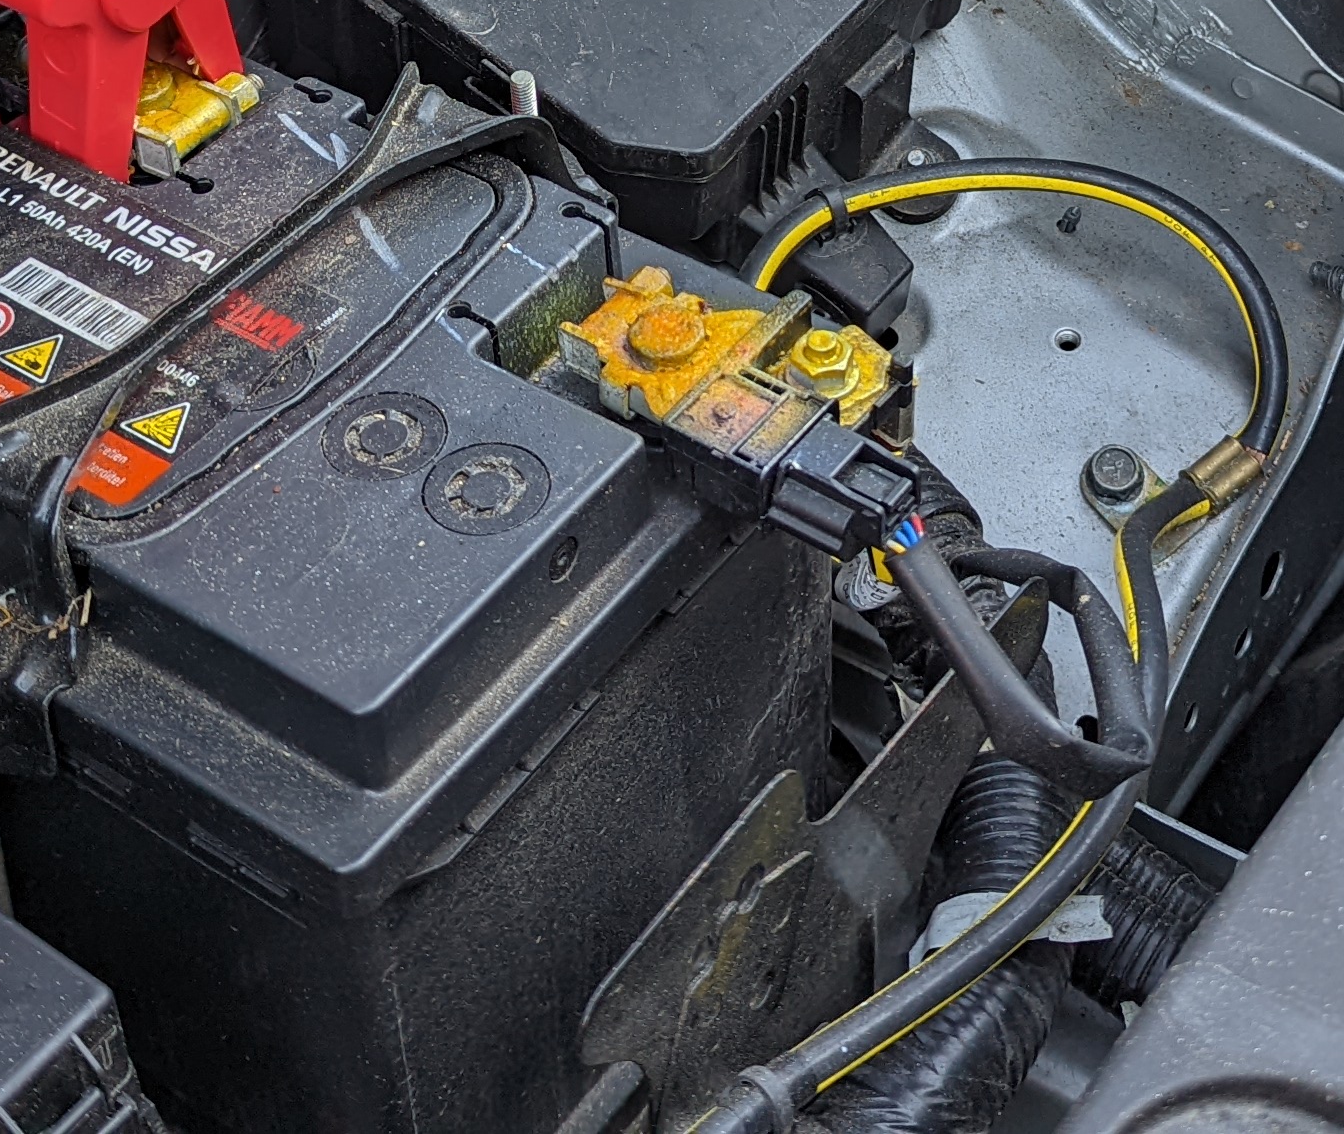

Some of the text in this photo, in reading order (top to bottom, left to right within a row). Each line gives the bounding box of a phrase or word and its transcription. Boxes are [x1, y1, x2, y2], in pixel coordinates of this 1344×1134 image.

[20, 200, 67, 230] 50Ah
[66, 224, 114, 254] 420A
[108, 246, 155, 275] (EN)
